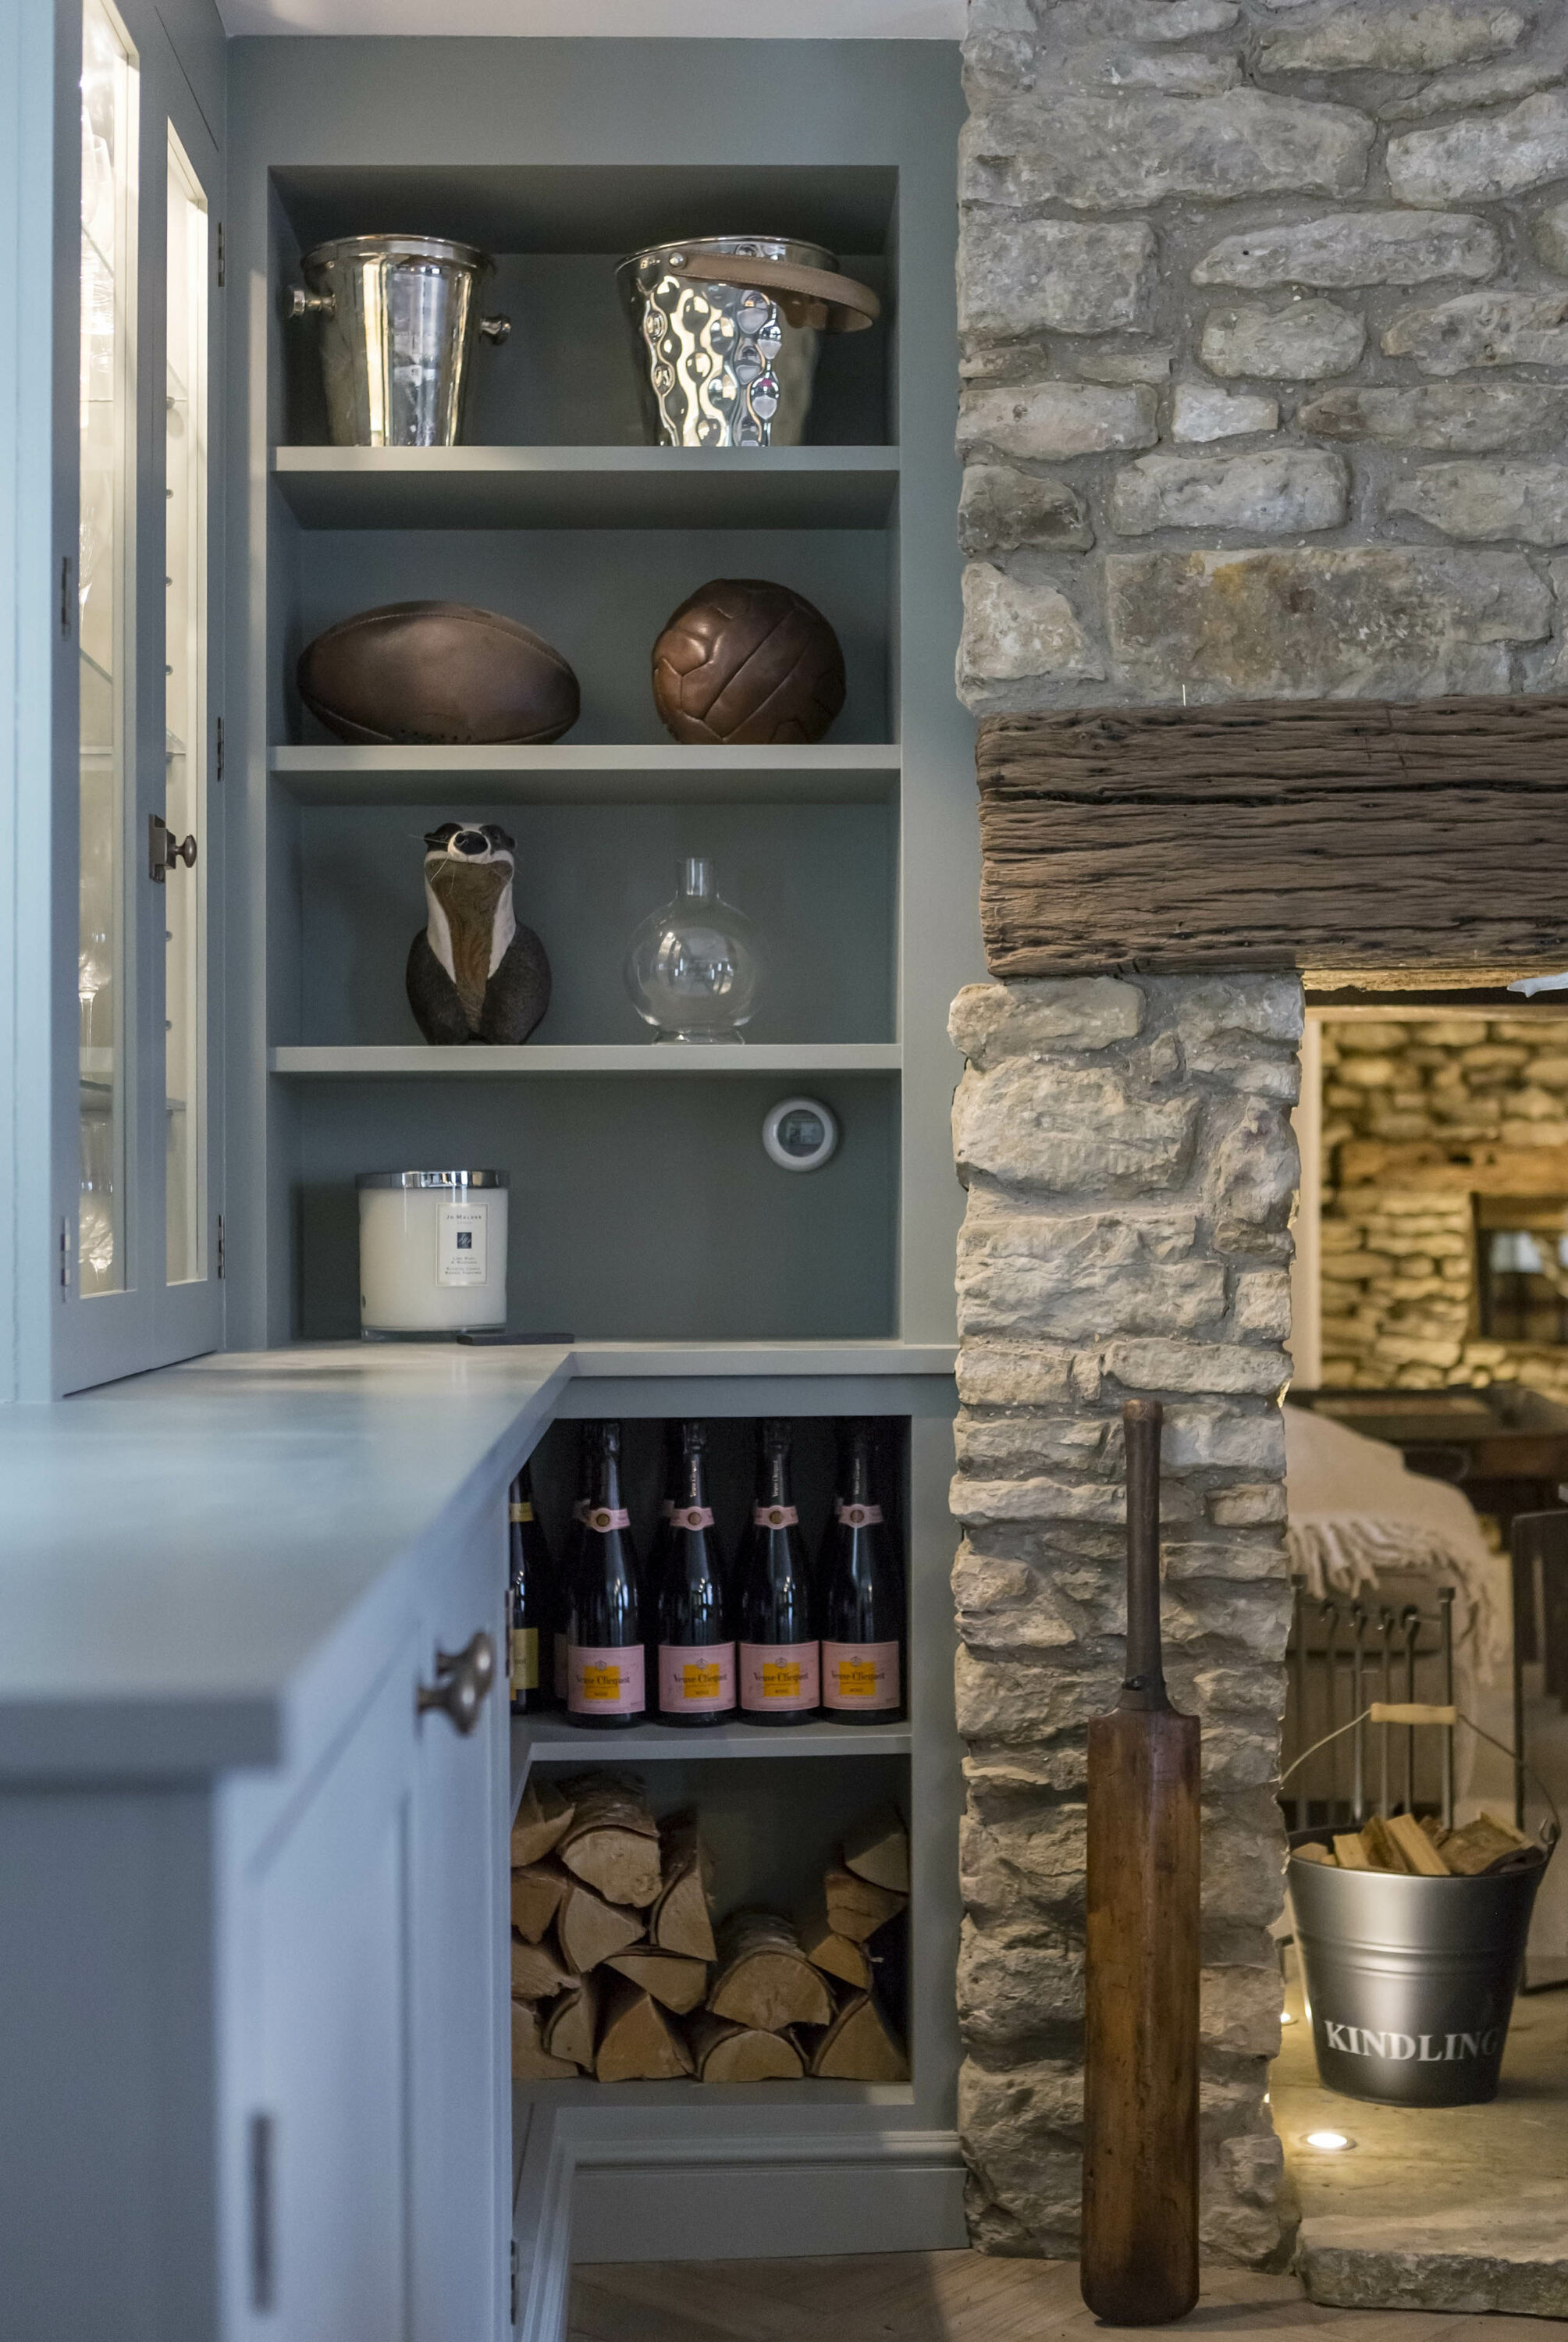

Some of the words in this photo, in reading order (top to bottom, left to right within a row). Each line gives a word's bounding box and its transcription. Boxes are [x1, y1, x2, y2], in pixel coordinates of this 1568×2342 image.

[596, 1674, 630, 1686] Clicquot
[673, 1673, 696, 1684] Veuve
[698, 1672, 727, 1685] Clicquot
[753, 1671, 776, 1682] Veuve
[777, 1671, 809, 1684] Clicquot
[852, 1670, 885, 1682] Clicquot
[1323, 2020, 1499, 2063] KINDLING
